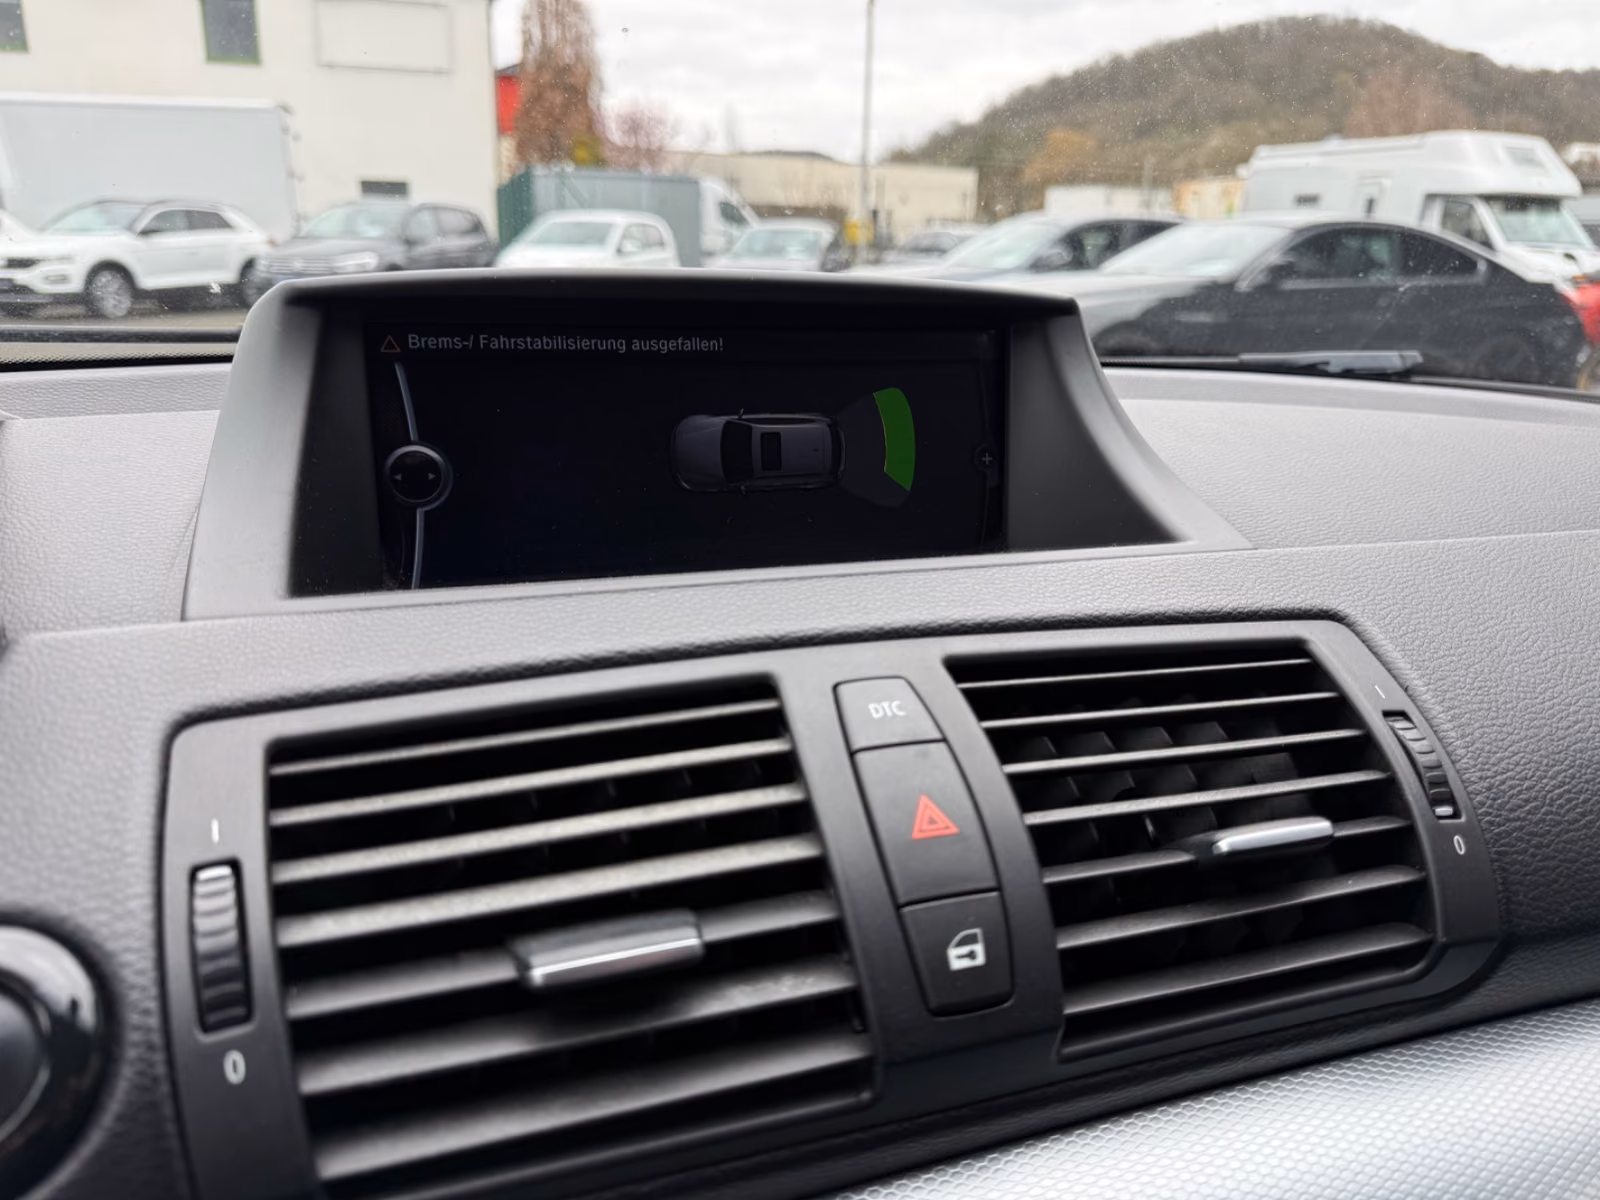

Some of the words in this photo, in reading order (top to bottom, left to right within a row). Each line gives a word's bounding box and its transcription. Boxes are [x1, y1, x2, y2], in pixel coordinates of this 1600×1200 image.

[407, 334, 474, 350] Brems-/
[479, 335, 626, 353] Fahrstabilisierung
[631, 337, 724, 353] ausgefallen!
[868, 700, 907, 719] DTC
